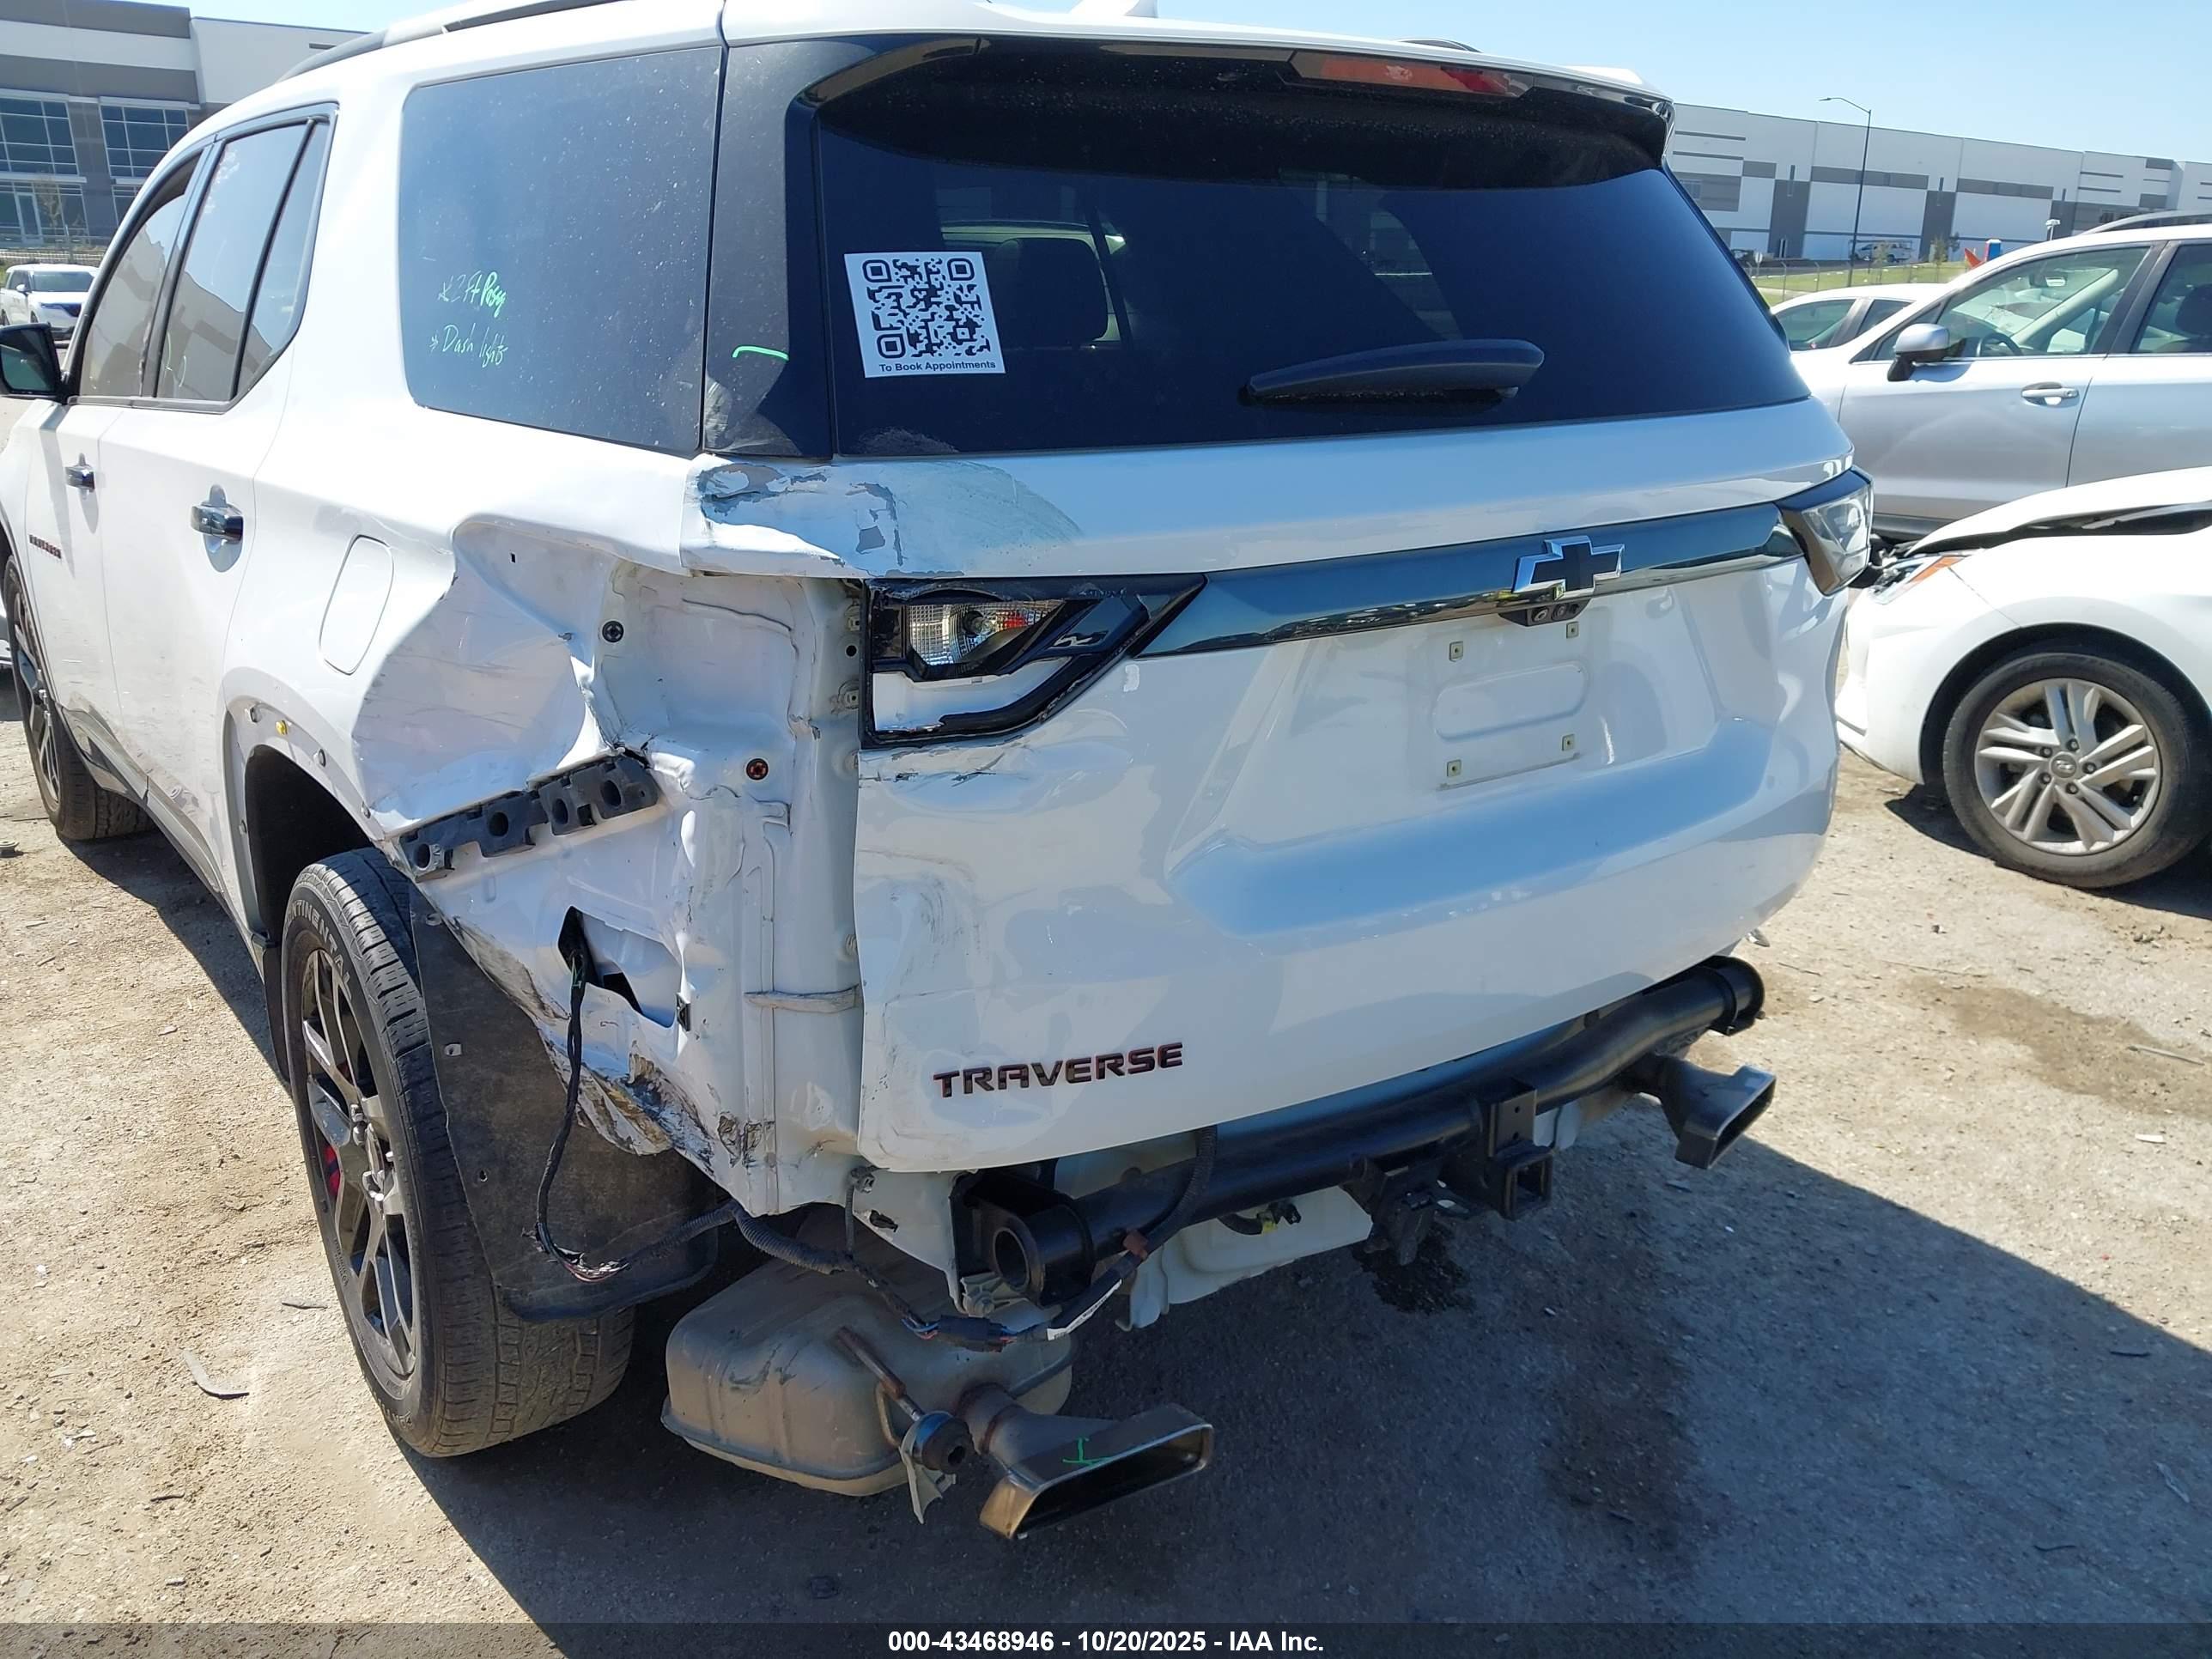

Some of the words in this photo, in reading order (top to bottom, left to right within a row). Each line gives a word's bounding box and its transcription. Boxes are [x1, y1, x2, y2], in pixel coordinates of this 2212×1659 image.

[442, 323, 476, 353] Dash
[895, 362, 922, 371] Book
[925, 361, 996, 371] Appointments
[283, 899, 353, 1002] NTINENTAL
[933, 1042, 1183, 1098] TRAVERSE
